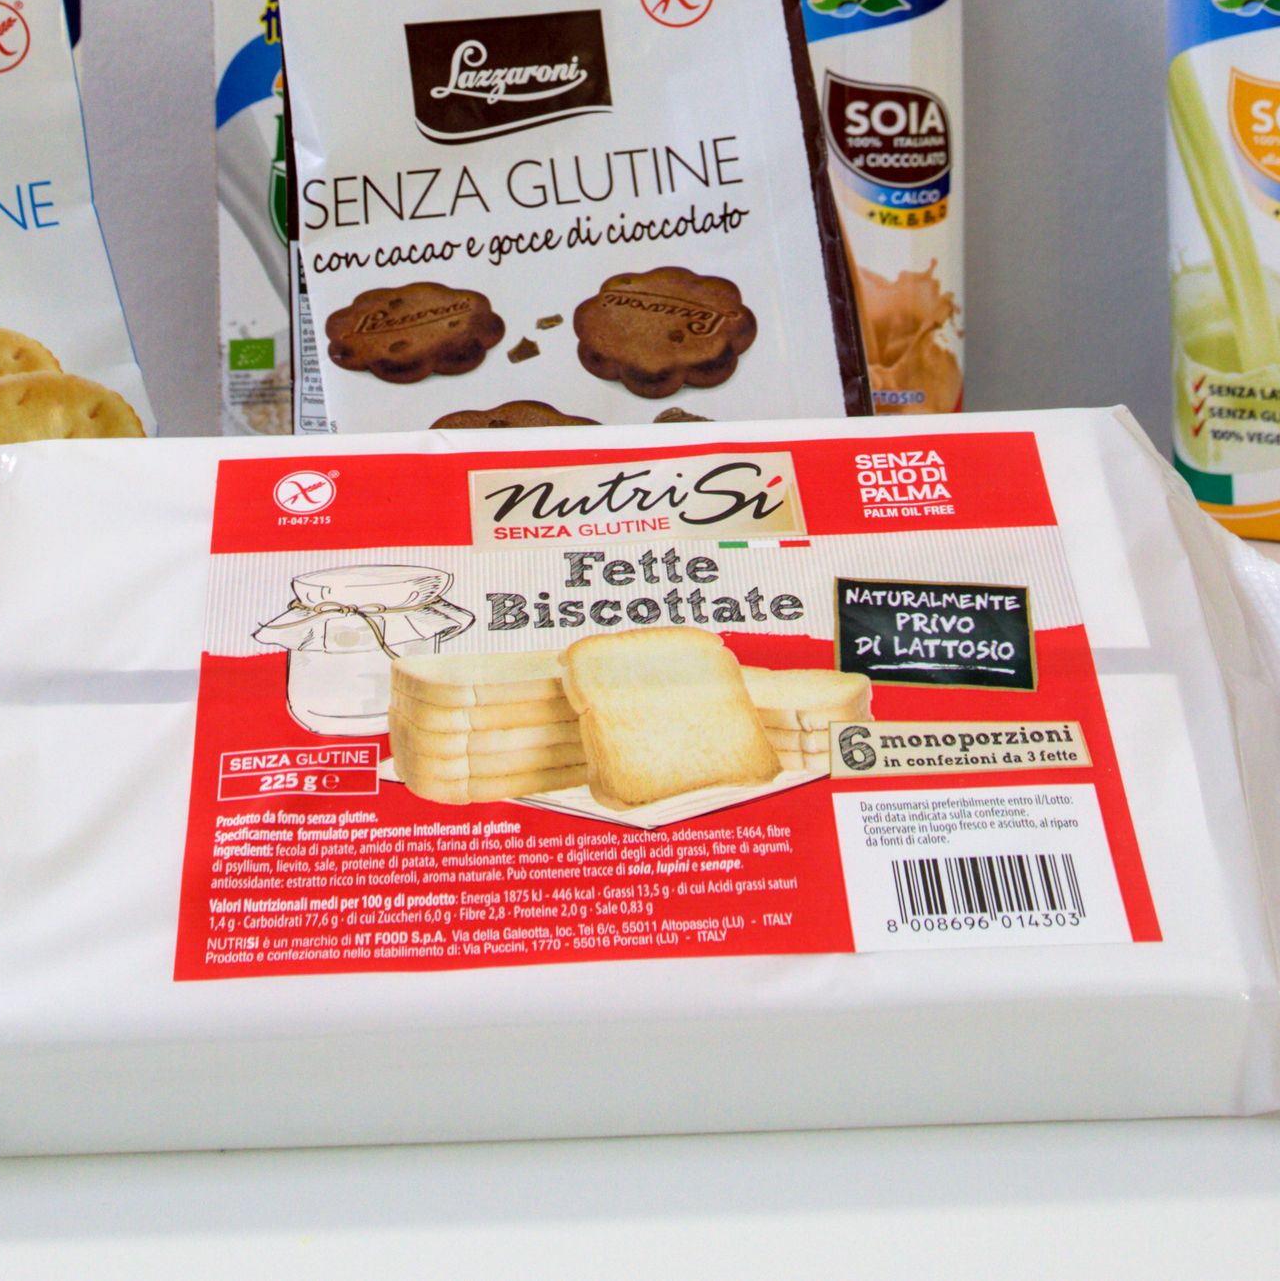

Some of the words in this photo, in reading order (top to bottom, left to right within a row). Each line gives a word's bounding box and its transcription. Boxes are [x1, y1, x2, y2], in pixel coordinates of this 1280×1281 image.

[430, 40, 587, 105] Lazzaroni
[844, 100, 945, 136] SOIA
[866, 152, 947, 168] CIOCCOLATO
[302, 165, 491, 230] SENZA
[506, 136, 744, 209] GLUTINE
[891, 189, 941, 205] CALCIO
[313, 248, 371, 273] con
[375, 241, 462, 267] cacao
[466, 238, 486, 257] e
[488, 229, 563, 266] gocce
[567, 218, 604, 250] di
[606, 203, 750, 244] cioccolato
[1208, 383, 1257, 398] SENZA
[1208, 407, 1257, 421] SENZA
[1209, 429, 1244, 443] 100%
[854, 450, 945, 470] SENZA
[857, 467, 918, 486] OLIO
[920, 466, 948, 483] DI
[859, 483, 953, 503] PALMA
[863, 507, 898, 518] PALM
[901, 506, 922, 517] OIL
[923, 504, 956, 516] FREE
[278, 516, 331, 527] IT-047-215
[493, 525, 572, 541] SENZA
[578, 516, 671, 538] GLUTINE
[563, 547, 720, 588] Fette
[486, 586, 805, 631] Biscottate
[845, 587, 1021, 611] NATURALMENTE
[838, 725, 878, 771] 6
[880, 724, 1074, 752] monoporzioni
[229, 753, 291, 773] SENZA
[295, 750, 370, 767] GLUTINE
[883, 754, 902, 768] in
[906, 751, 997, 768] confezioni
[1002, 751, 1022, 764] da
[1027, 750, 1037, 763] 3
[1039, 749, 1078, 763] fette
[259, 772, 299, 792] 225
[302, 774, 319, 793] g
[859, 800, 874, 813] Da
[875, 798, 931, 812] consumarsi
[932, 794, 1007, 811] preferibilmente
[1008, 795, 1034, 808] entro
[216, 812, 261, 828] Prodotto
[262, 810, 276, 824] da
[277, 809, 306, 825] forno
[307, 812, 337, 825] senza
[338, 809, 379, 827] glutine.
[354, 931, 372, 946] NT
[374, 930, 409, 946] FOOD
[411, 929, 448, 946] S.p.A.
